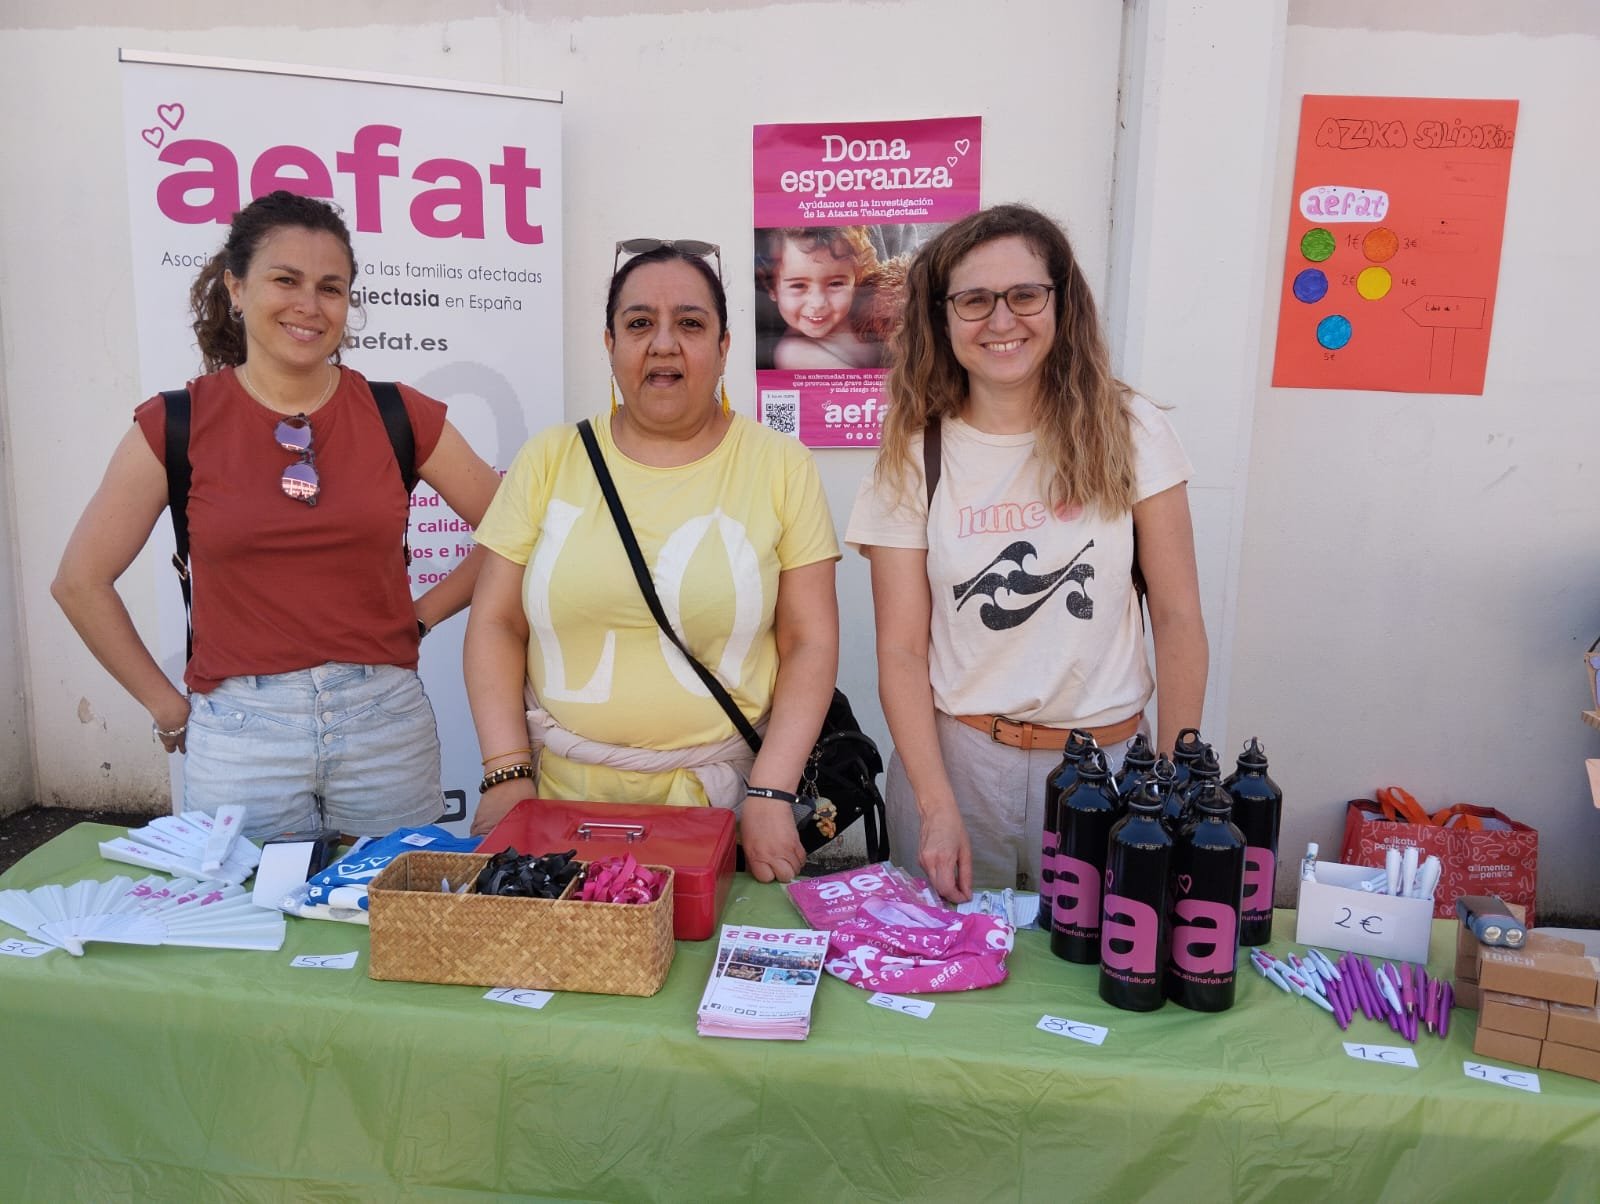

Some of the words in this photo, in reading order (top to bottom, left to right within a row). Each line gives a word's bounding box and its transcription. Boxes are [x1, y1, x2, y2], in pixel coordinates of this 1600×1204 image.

[821, 135, 911, 163] Dona
[157, 124, 544, 245] aefat
[780, 167, 953, 198] esperanza
[804, 210, 814, 218] de
[816, 210, 826, 218] la
[827, 210, 859, 218] Ataxia
[860, 208, 929, 217] Telangiectasia
[860, 200, 869, 208] la
[871, 198, 934, 208] investigación
[1306, 193, 1386, 218] aefat
[365, 264, 375, 275] a
[380, 261, 400, 276] las
[406, 262, 463, 280] familias
[468, 268, 542, 284] afectadas
[445, 296, 464, 308] en
[469, 294, 522, 313] España
[439, 548, 449, 558] e
[743, 931, 827, 946] aefat
[1101, 893, 1159, 974] a
[1171, 898, 1237, 975] a
[930, 960, 963, 988] aefat
